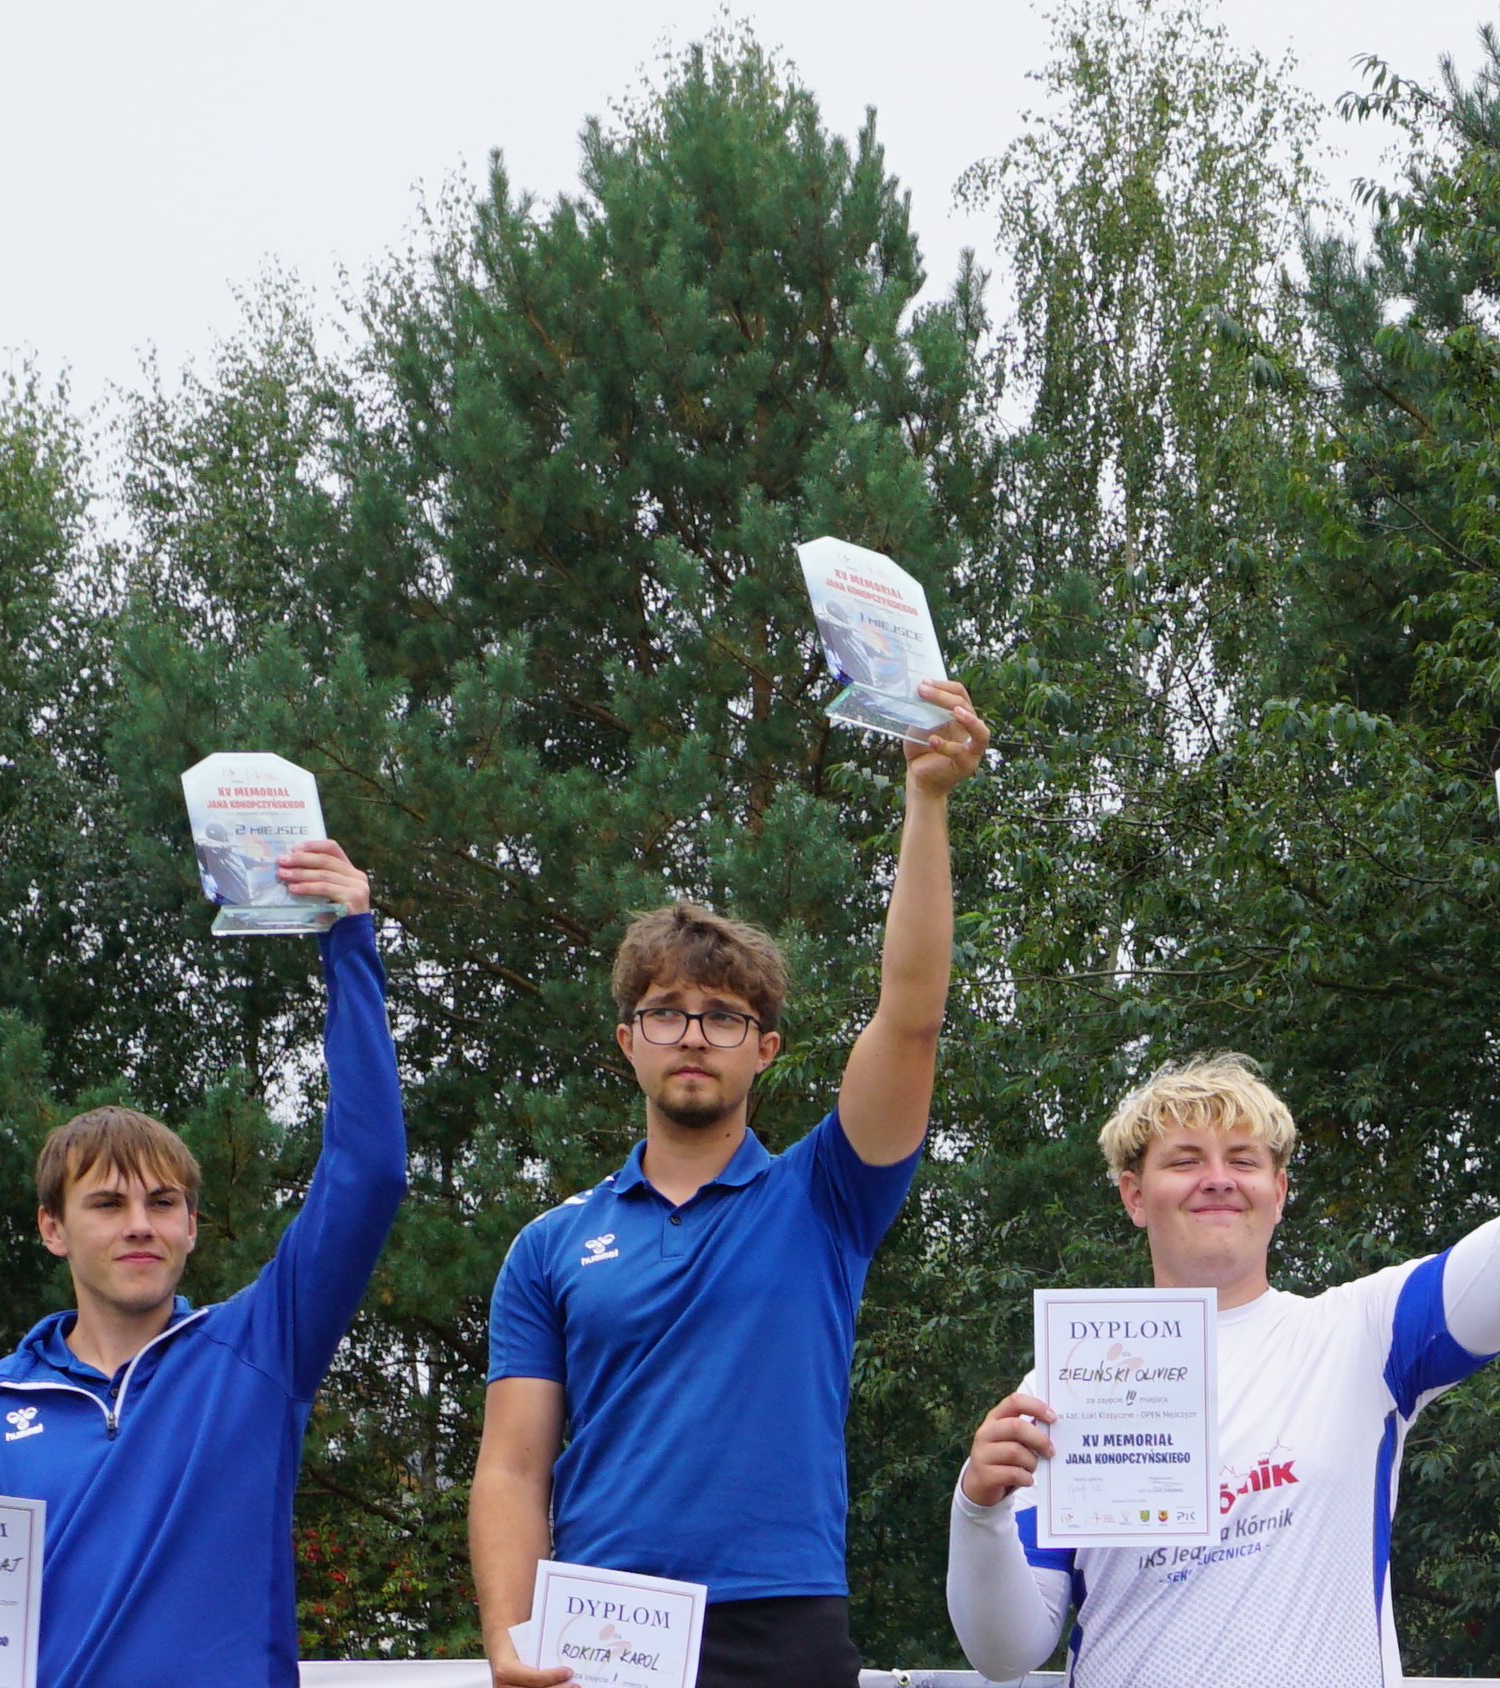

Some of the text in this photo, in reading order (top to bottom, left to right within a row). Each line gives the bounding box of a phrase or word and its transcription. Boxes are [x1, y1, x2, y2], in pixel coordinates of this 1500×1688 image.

[868, 618, 923, 642] MIEJSCE
[217, 787, 232, 797] XV
[235, 825, 309, 835] 2 MIEJSCE
[581, 1249, 618, 1267] hummel
[1070, 1320, 1182, 1339] DYPLOM
[1058, 1360, 1130, 1382] ZIELIŃSKI
[1082, 1434, 1174, 1447] XV MEMORIAŁ
[1065, 1449, 1191, 1465] JANA KONOPCZYŃSKIEGO
[1236, 1508, 1294, 1538] Kórnik
[566, 1596, 671, 1629] DYPLOM
[561, 1643, 660, 1671] ROKITA KAROL
